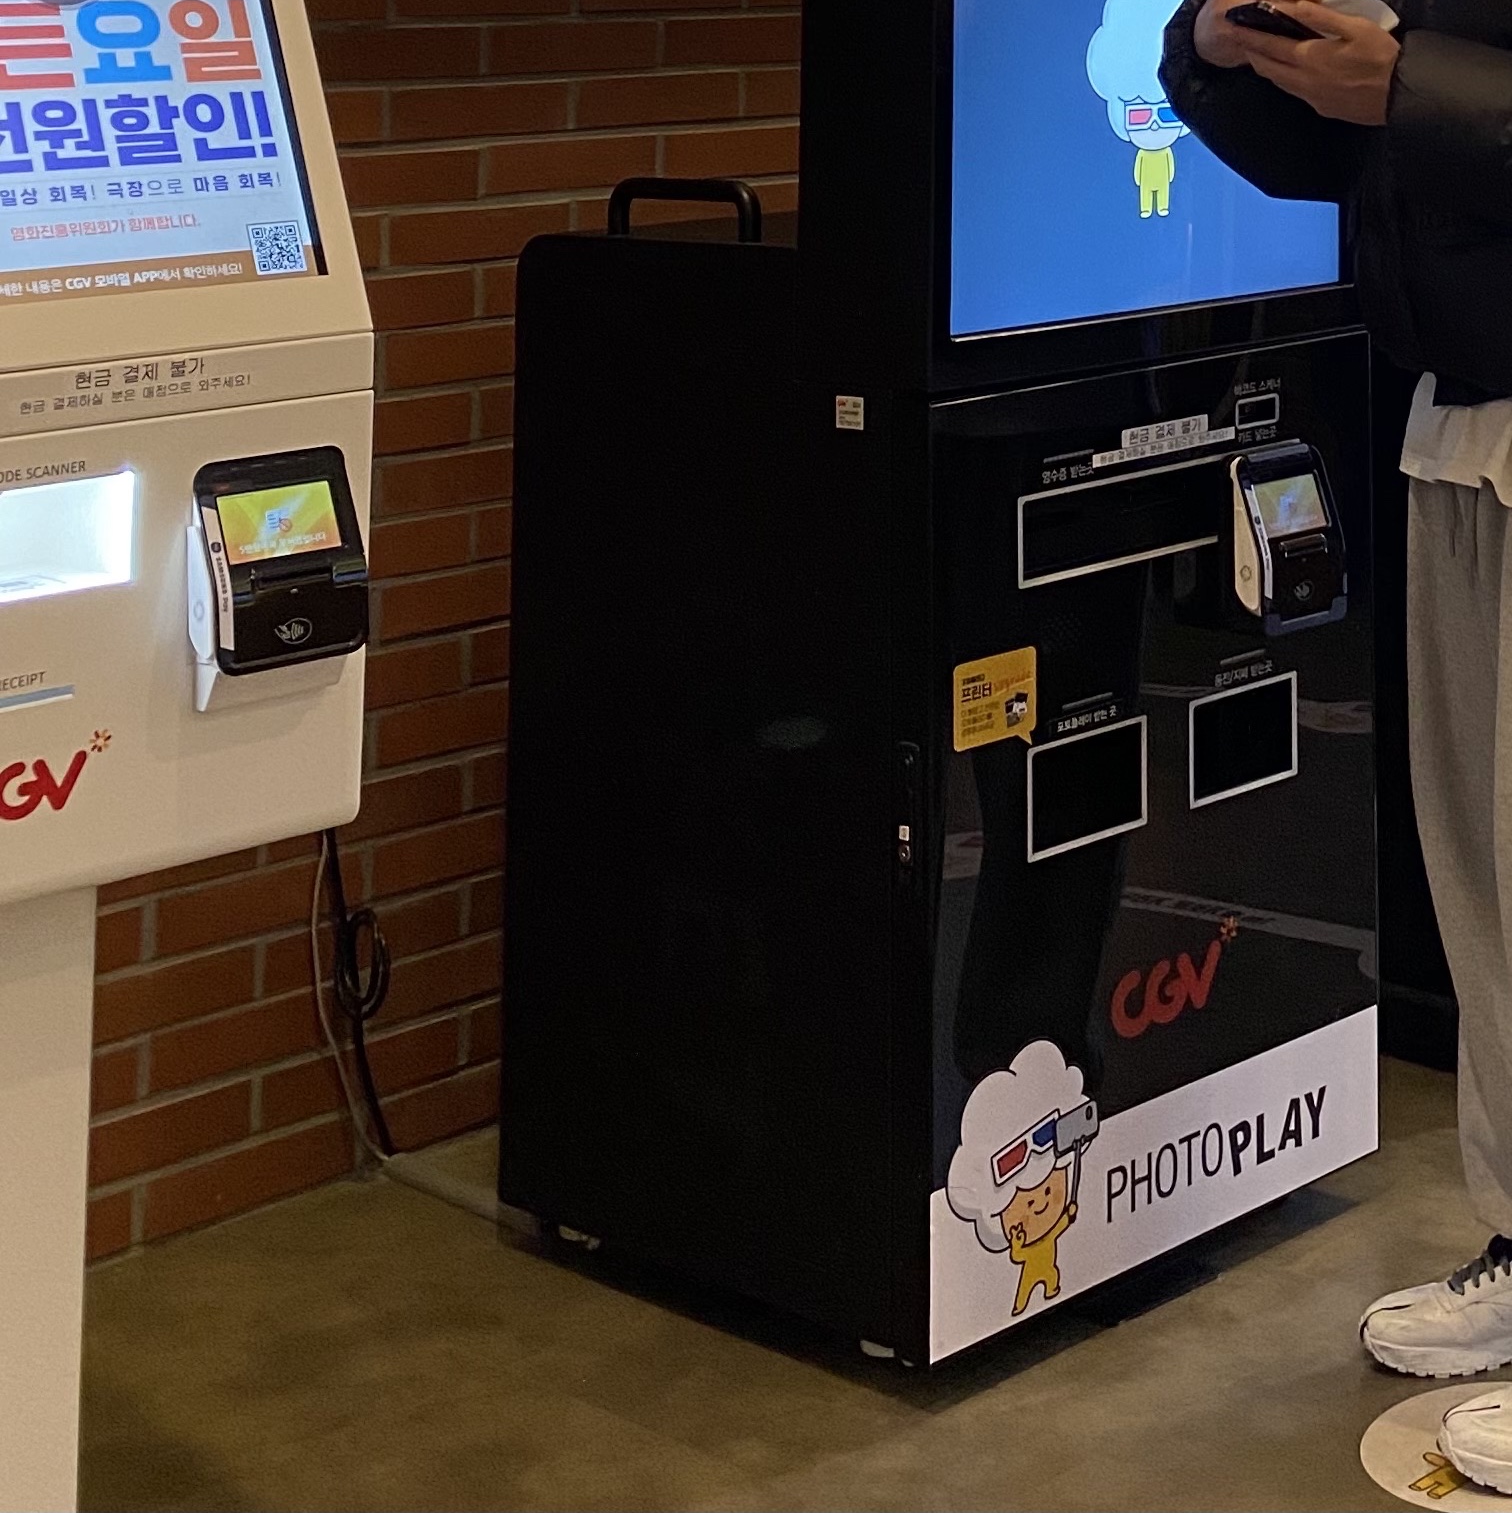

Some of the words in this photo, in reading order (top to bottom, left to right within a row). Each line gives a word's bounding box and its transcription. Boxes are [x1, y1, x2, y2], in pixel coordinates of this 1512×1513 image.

[49, 184, 95, 203] 회복!
[105, 177, 184, 200] 극장으로
[192, 173, 229, 193] 마음
[237, 170, 282, 191] 회복!
[9, 218, 126, 243] 영화진흥위원회가
[65, 276, 91, 290] CGV
[94, 271, 132, 289] 모바일
[74, 367, 113, 391] 현금
[122, 361, 159, 384] 결제
[169, 355, 206, 379] 불가
[19, 399, 47, 416] 현금
[52, 394, 104, 412] 결제하실
[110, 389, 136, 405] 분은
[26, 460, 87, 480] SCANNER
[0, 670, 47, 691] ECEIPT
[960, 681, 992, 704] 프린터
[1110, 939, 1222, 1039] CGV
[1106, 1085, 1328, 1224] PHOTOPLAY
